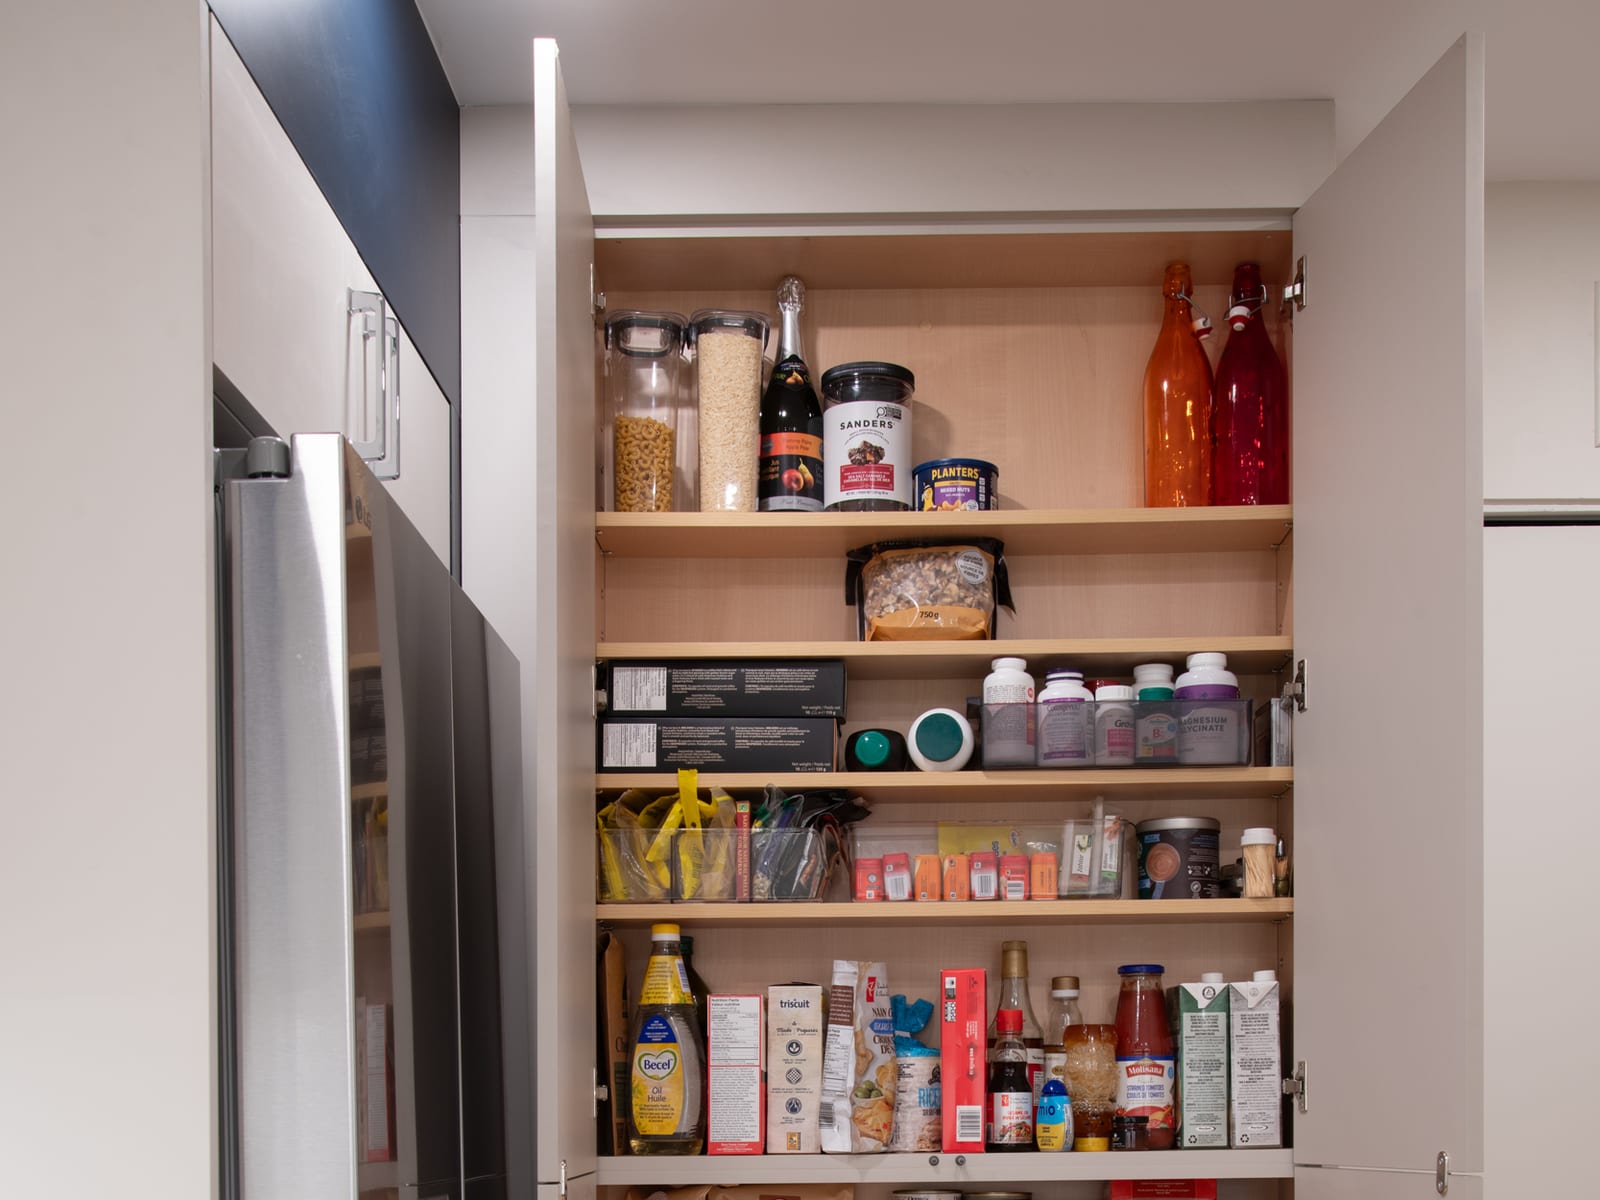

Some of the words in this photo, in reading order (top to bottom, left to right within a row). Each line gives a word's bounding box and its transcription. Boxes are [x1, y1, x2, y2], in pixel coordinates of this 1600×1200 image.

[840, 420, 893, 430] SANDERS
[932, 467, 979, 480] PLANTERS
[1178, 716, 1227, 724] AGNESIUM
[780, 999, 810, 1008] triscuit
[644, 1060, 670, 1070] Becel
